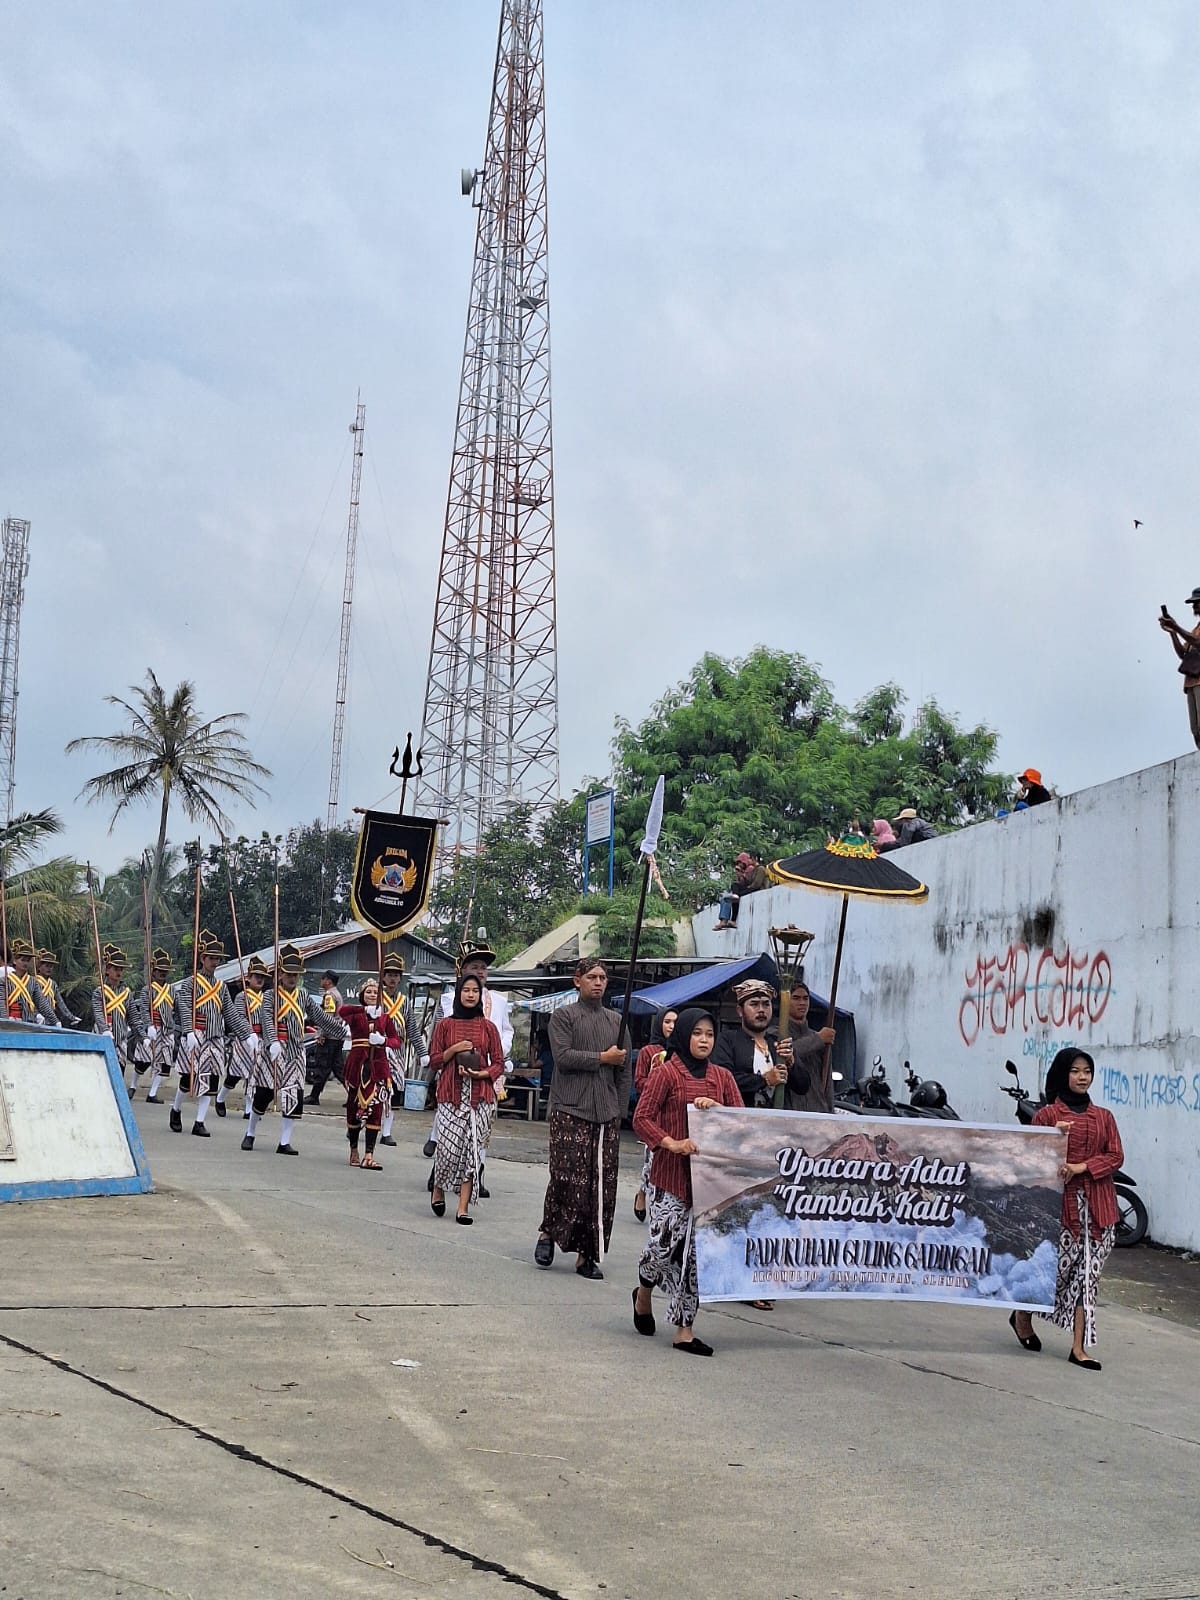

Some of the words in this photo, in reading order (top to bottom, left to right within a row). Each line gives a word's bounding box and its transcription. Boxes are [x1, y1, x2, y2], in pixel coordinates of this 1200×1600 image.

[775, 1147, 894, 1185] Upacara
[897, 1154, 967, 1187] Adat
[773, 1184, 889, 1217] "Tambak
[894, 1190, 965, 1222] Kali"
[744, 1237, 840, 1268] PADUKUHAN
[842, 1239, 904, 1270] GULING
[904, 1242, 993, 1275] GADINGAN
